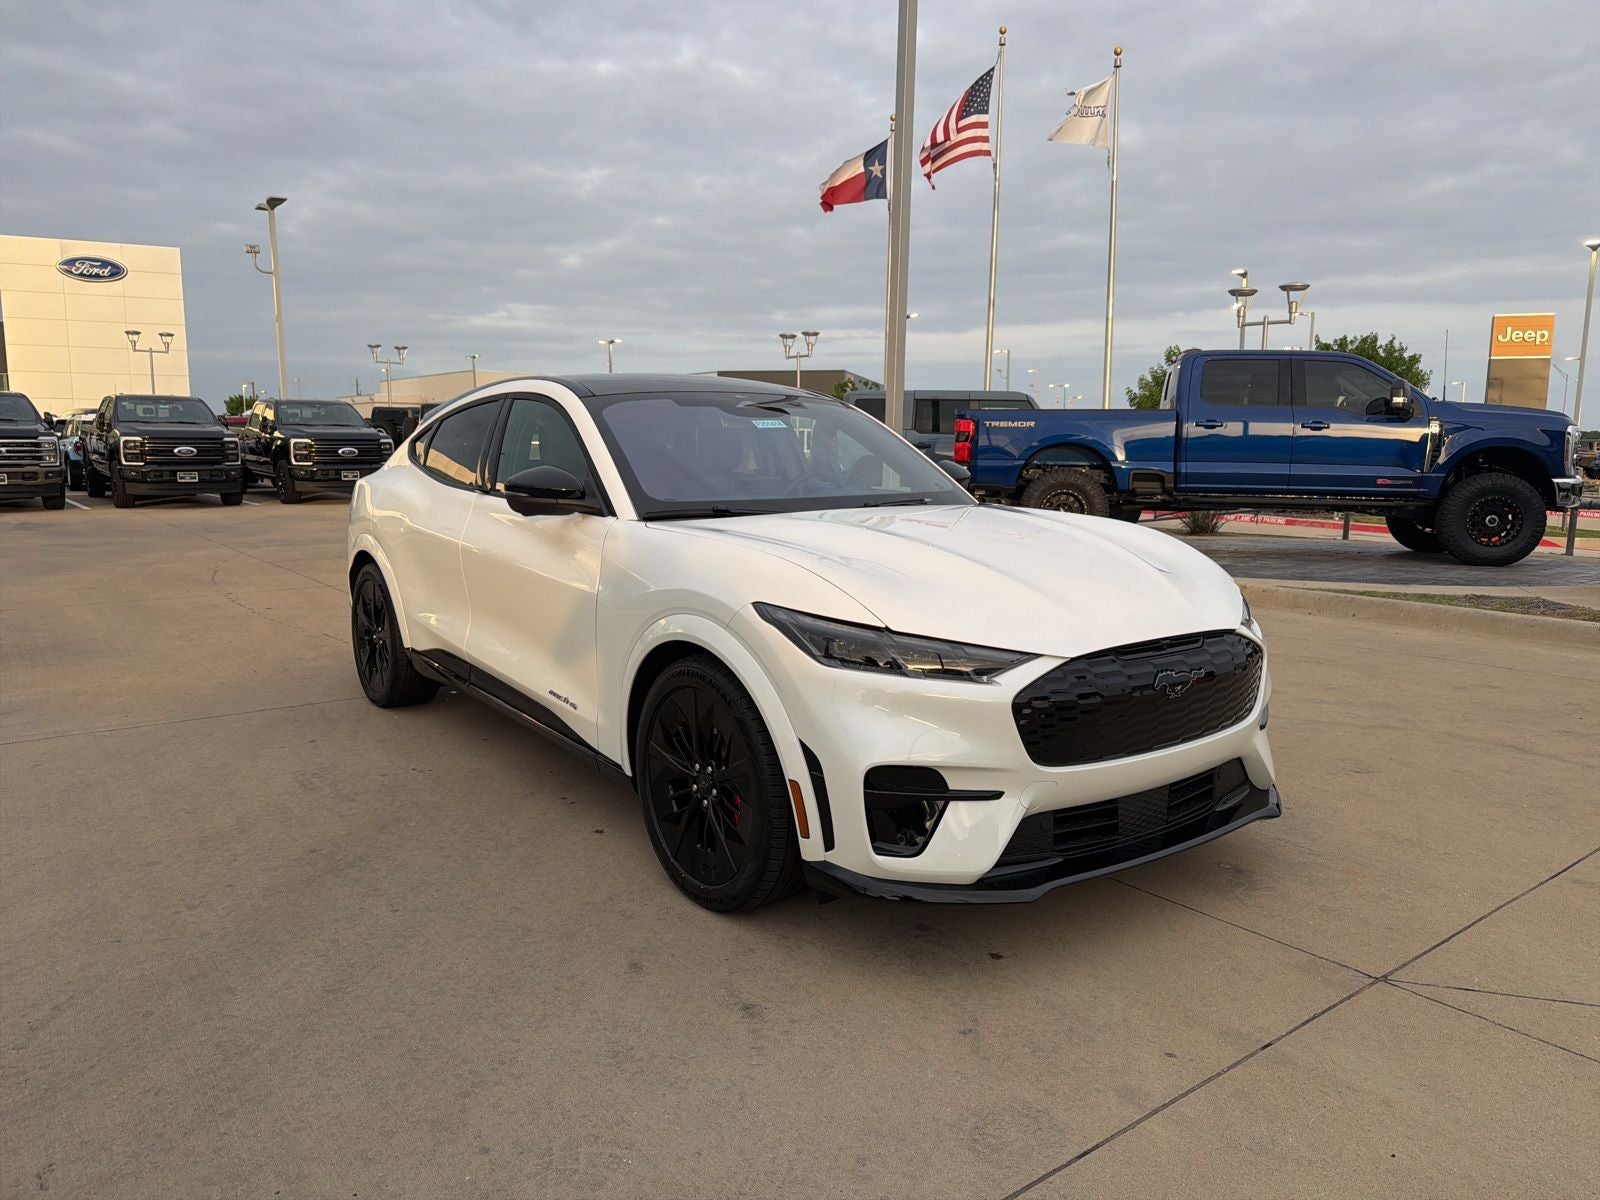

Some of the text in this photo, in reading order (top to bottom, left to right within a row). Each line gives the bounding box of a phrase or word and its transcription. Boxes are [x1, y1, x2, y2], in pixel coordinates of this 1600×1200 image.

[72, 260, 111, 276] Ford
[1498, 326, 1549, 345] Jeep
[1264, 517, 1286, 525] PARKING
